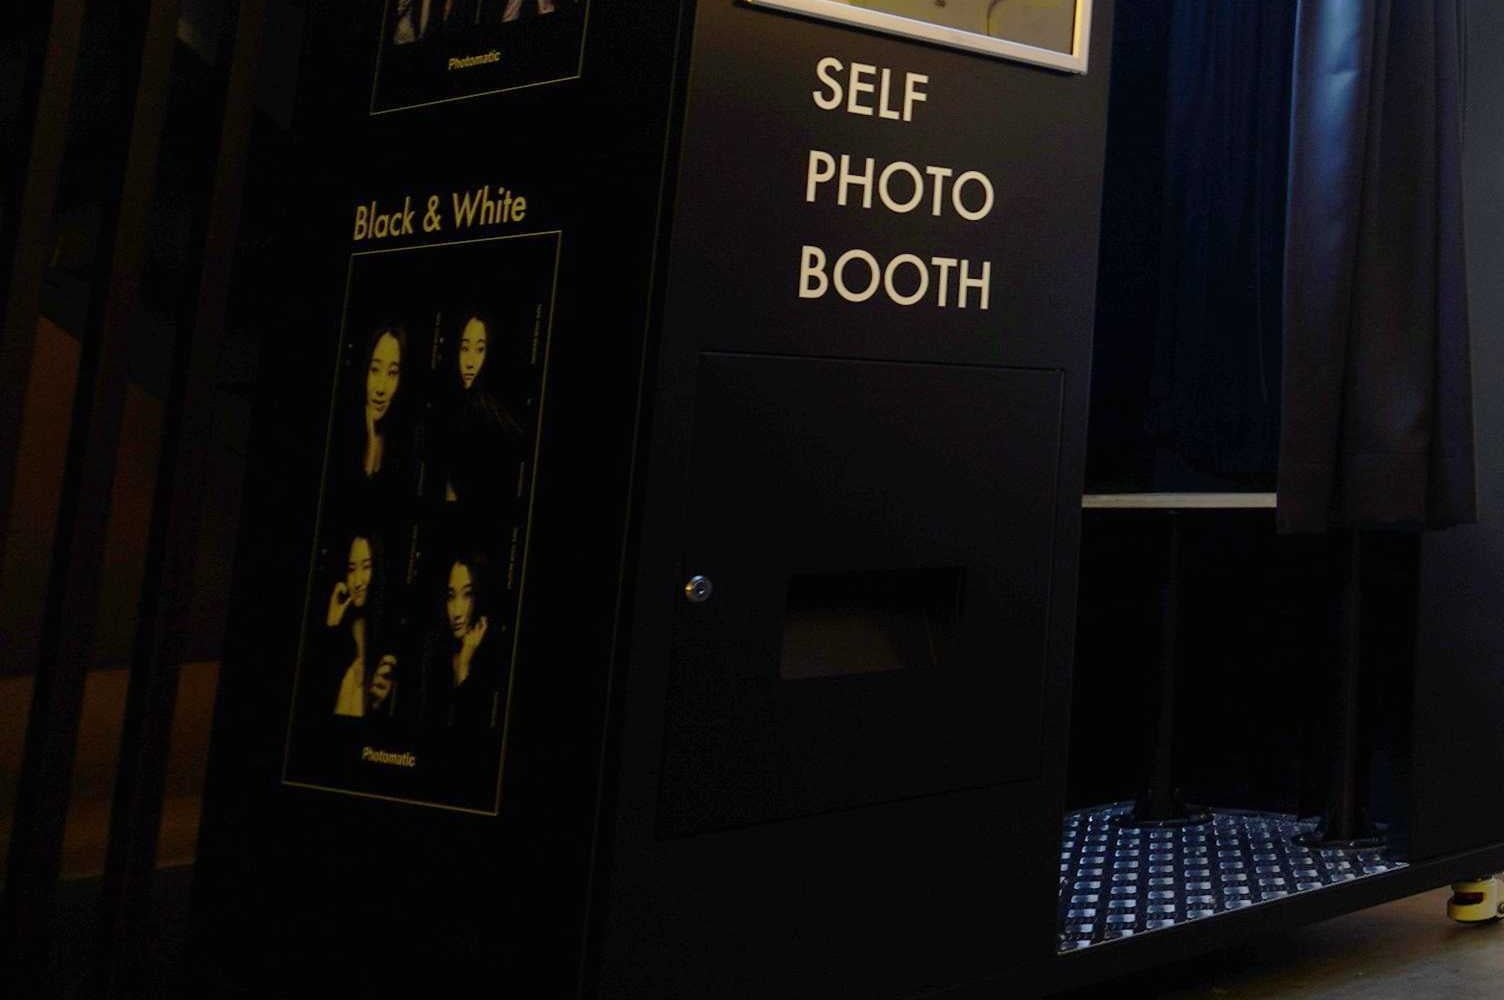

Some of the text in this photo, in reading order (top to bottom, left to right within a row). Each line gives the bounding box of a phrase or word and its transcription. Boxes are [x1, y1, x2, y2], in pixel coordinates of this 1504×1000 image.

[447, 50, 501, 71] Photomatic
[811, 56, 929, 122] SELF
[352, 185, 528, 241] Black & White
[805, 149, 995, 221] PHOTO
[798, 245, 992, 311] BOOTH
[361, 745, 417, 769] Photomatic
